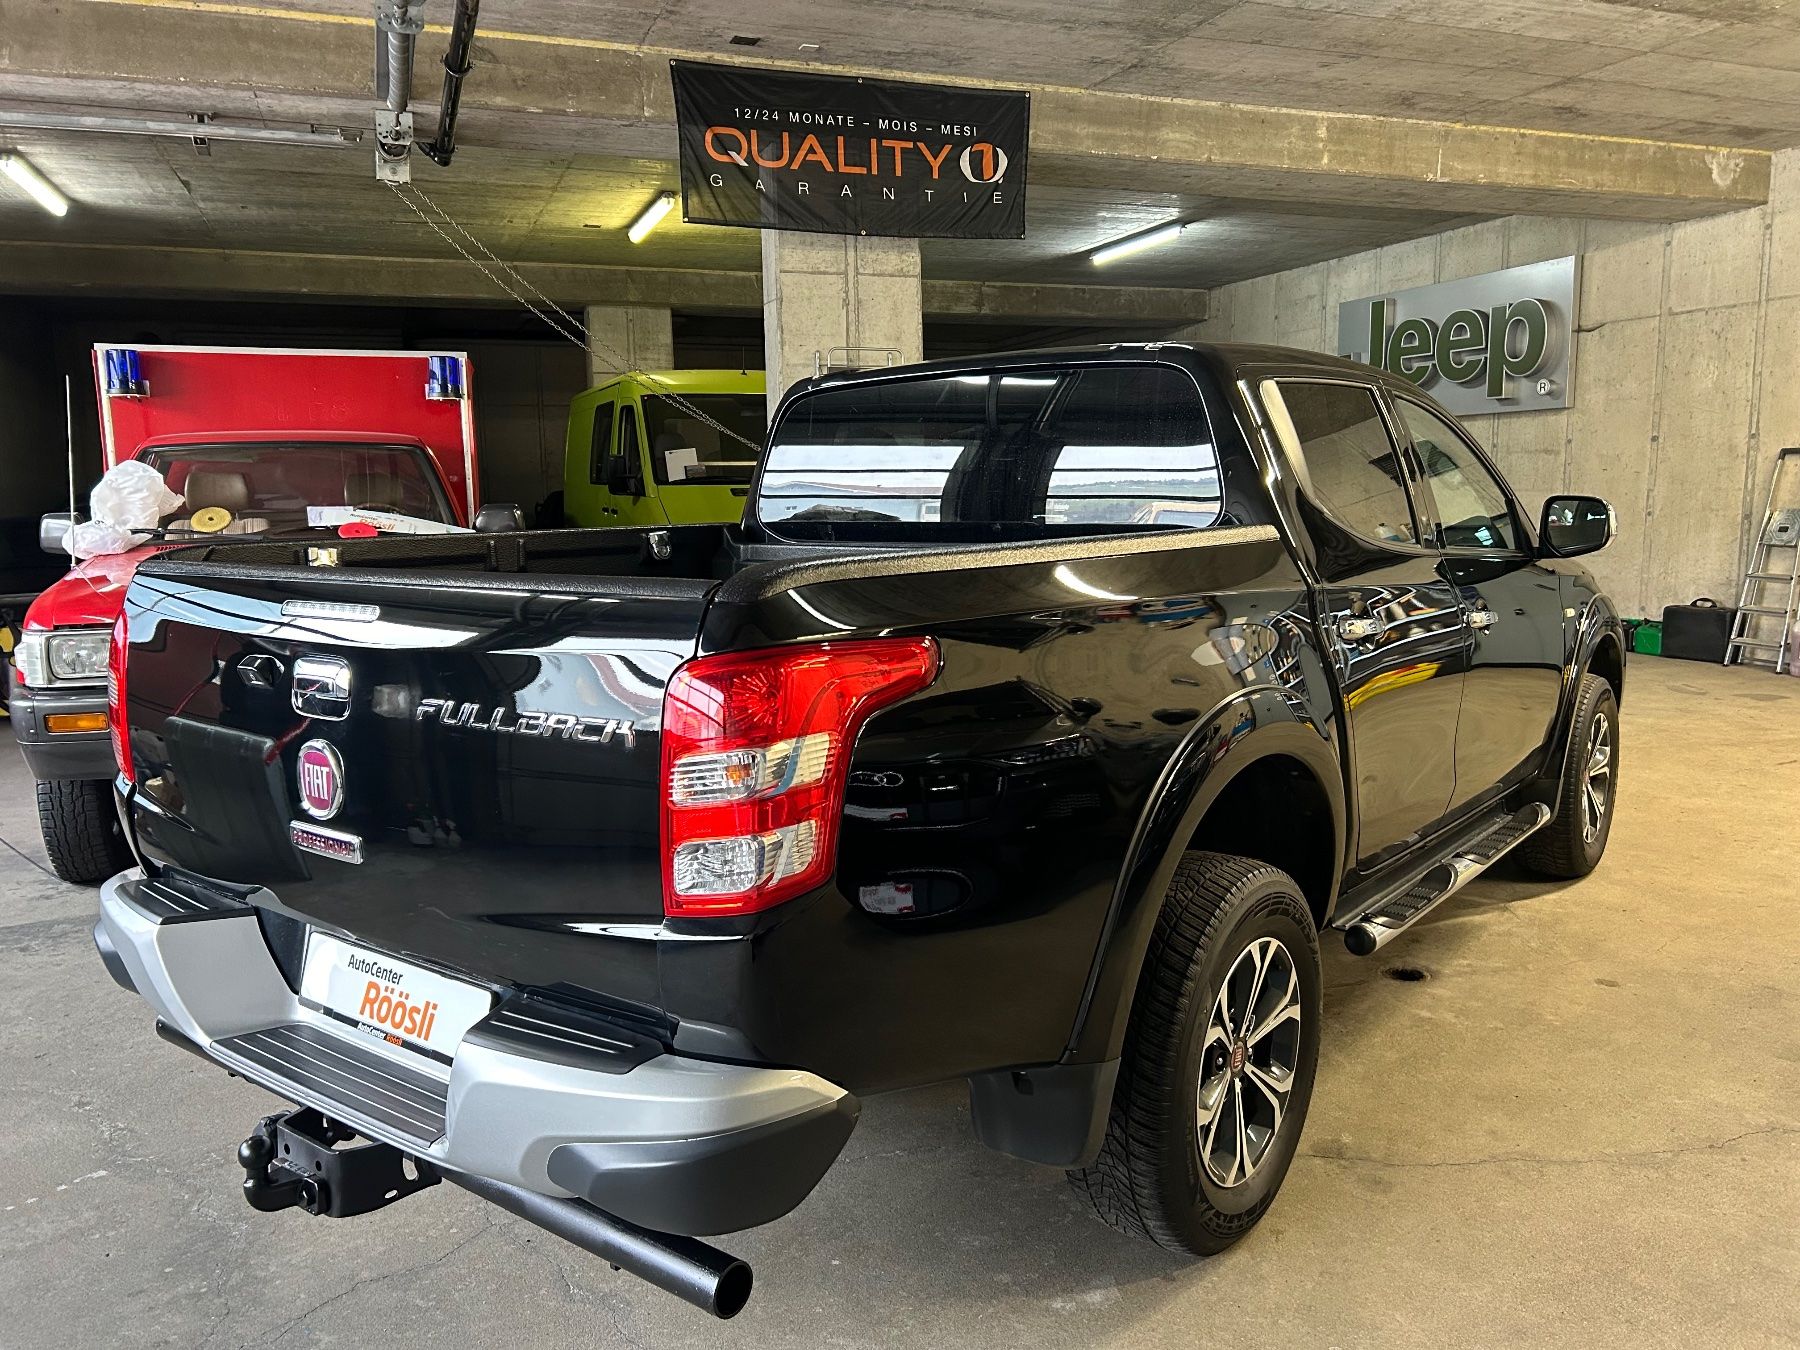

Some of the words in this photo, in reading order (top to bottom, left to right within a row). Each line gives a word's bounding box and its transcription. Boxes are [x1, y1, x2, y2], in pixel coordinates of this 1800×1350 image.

[734, 107, 779, 121] 12/24
[789, 111, 855, 127] MONATE
[878, 118, 917, 132] MOIS
[941, 124, 977, 136] MESI
[704, 126, 953, 180] QUALITY
[709, 173, 1003, 204] GARANTIE
[1339, 297, 1548, 399] Jeep
[416, 698, 636, 749] FULLBACK
[304, 762, 330, 800] FIAT
[293, 830, 353, 858] PROFESSIONAL
[347, 953, 404, 985] AutoCenter
[359, 980, 438, 1042] Röösli
[356, 1022, 386, 1041] AutoCenter
